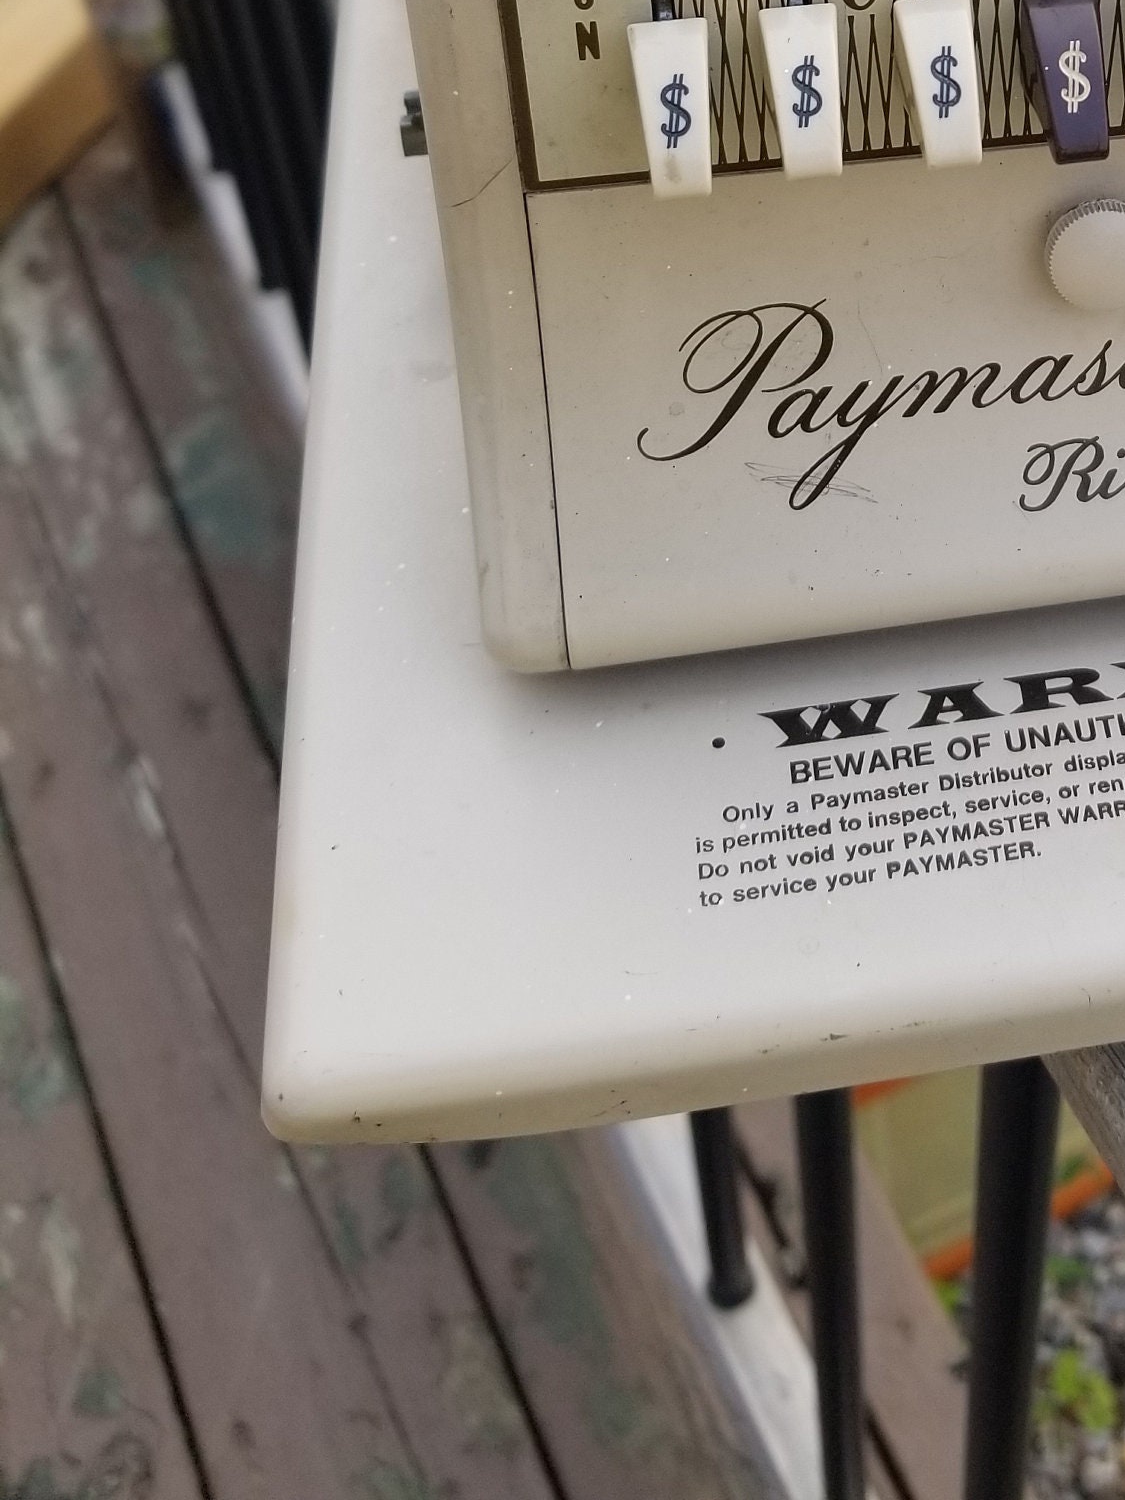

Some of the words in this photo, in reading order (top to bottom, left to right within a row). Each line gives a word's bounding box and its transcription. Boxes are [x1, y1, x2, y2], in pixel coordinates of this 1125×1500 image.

[660, 74, 692, 149] $
[791, 55, 823, 128] $
[930, 46, 962, 118] $
[1059, 40, 1091, 113] $
[722, 801, 775, 824] Only
[786, 800, 799, 815] a
[810, 779, 929, 812] Paymaster
[938, 761, 1053, 792] Distributor
[789, 741, 935, 785] BEWARE
[947, 733, 992, 761] OF
[695, 836, 715, 854] is
[722, 816, 832, 854] permitted
[838, 815, 862, 833] to
[868, 800, 957, 829] inspect,
[964, 786, 1051, 814] service,
[1058, 783, 1081, 800] or
[698, 861, 730, 880] Do
[740, 855, 777, 874] not
[786, 846, 835, 867] void
[844, 838, 895, 862] your
[903, 811, 1050, 849] PAYMASTER
[700, 890, 722, 907] to
[732, 876, 818, 903] service
[825, 868, 876, 893] your
[886, 841, 1042, 879] PAYMASTER.
